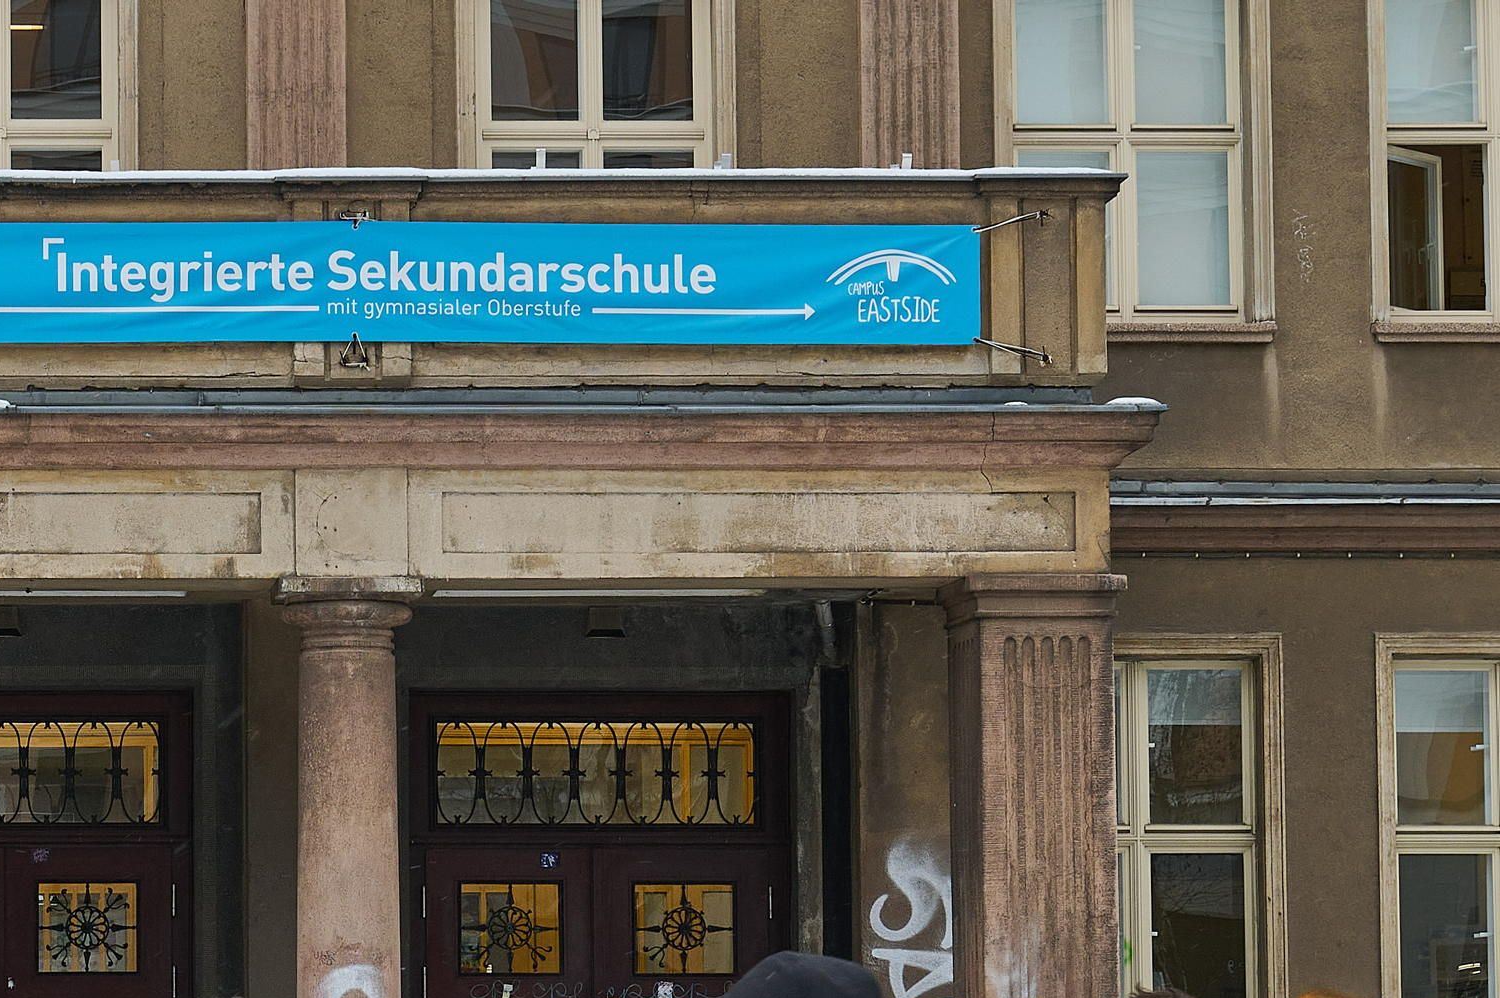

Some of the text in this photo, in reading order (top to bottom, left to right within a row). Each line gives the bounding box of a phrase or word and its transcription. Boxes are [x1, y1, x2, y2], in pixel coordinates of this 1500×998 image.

[57, 250, 716, 302] Integrierte Sekundarschule
[847, 281, 885, 295] CAMPUS
[327, 298, 581, 319] mit gymnasialer Oberstufe
[858, 296, 940, 322] EASTSIDE
